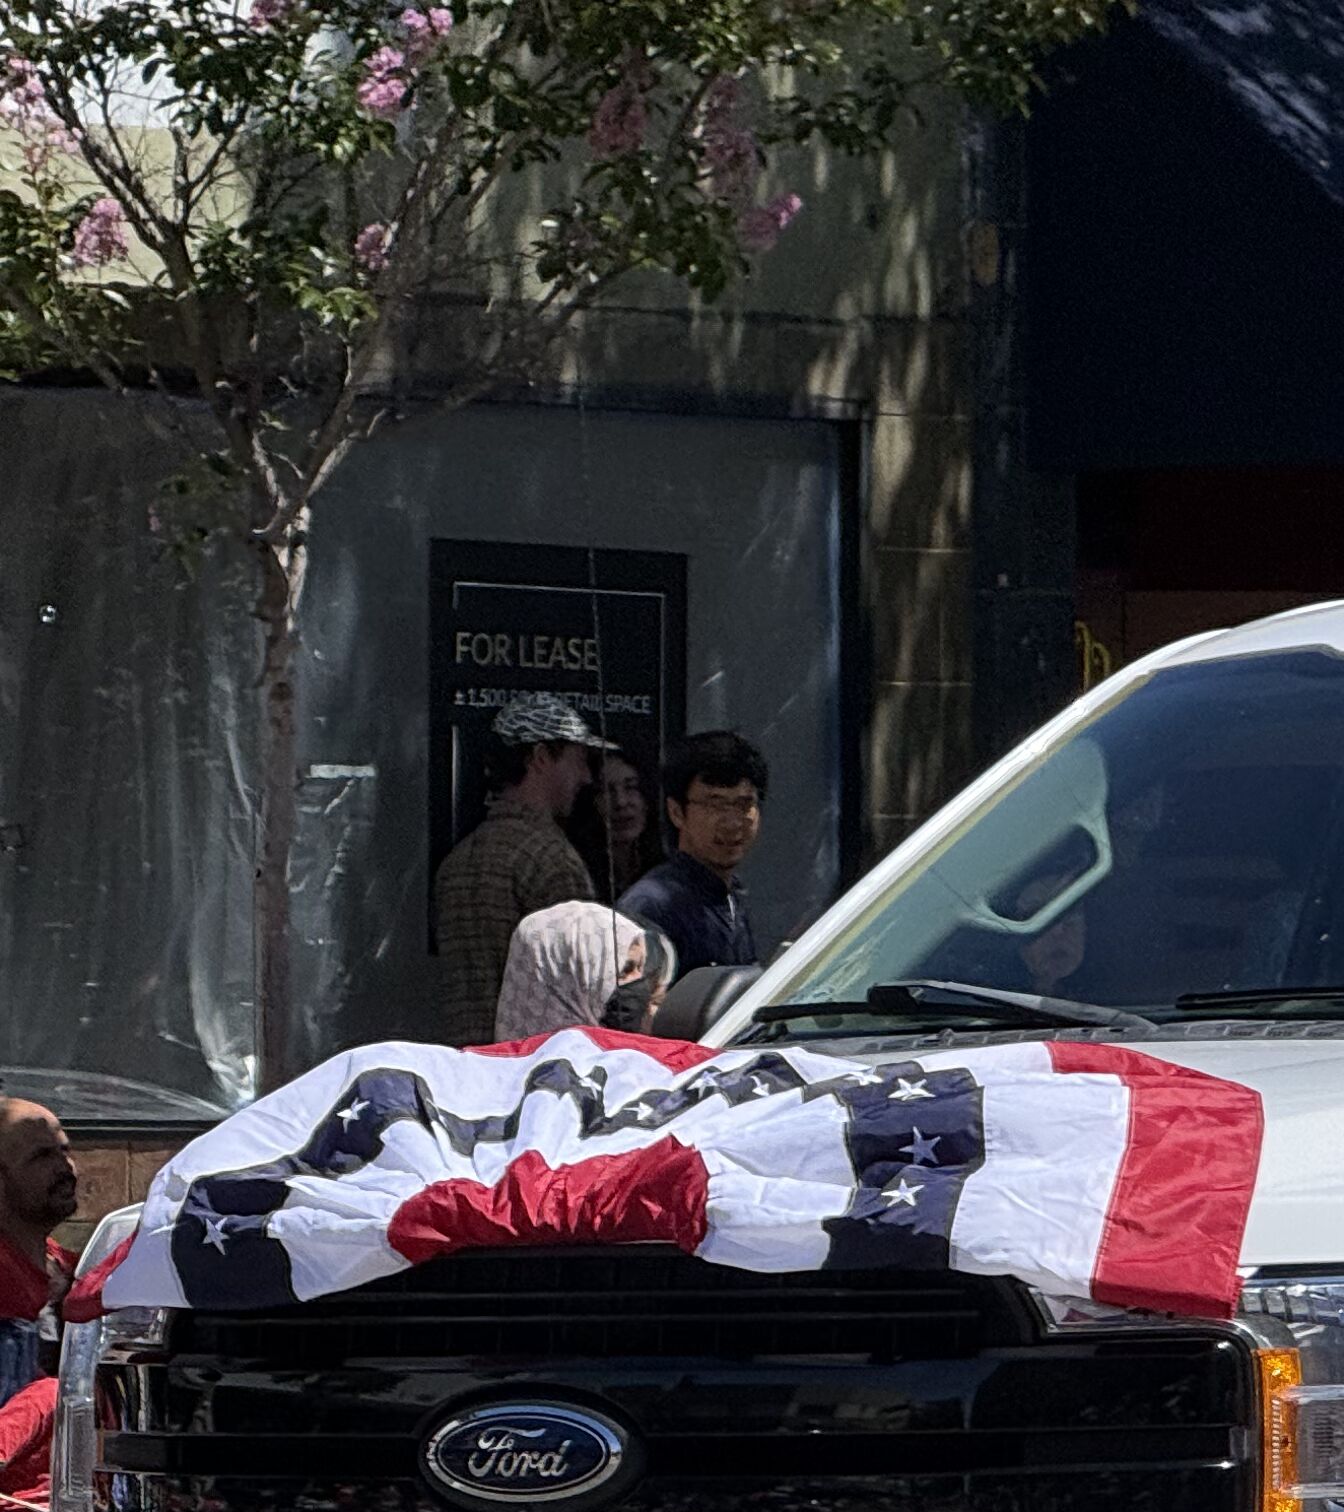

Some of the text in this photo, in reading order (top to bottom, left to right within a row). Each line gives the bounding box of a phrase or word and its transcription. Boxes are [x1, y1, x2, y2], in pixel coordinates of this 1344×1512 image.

[455, 631, 600, 671] FOR LEASE
[468, 1426, 570, 1479] Ford
